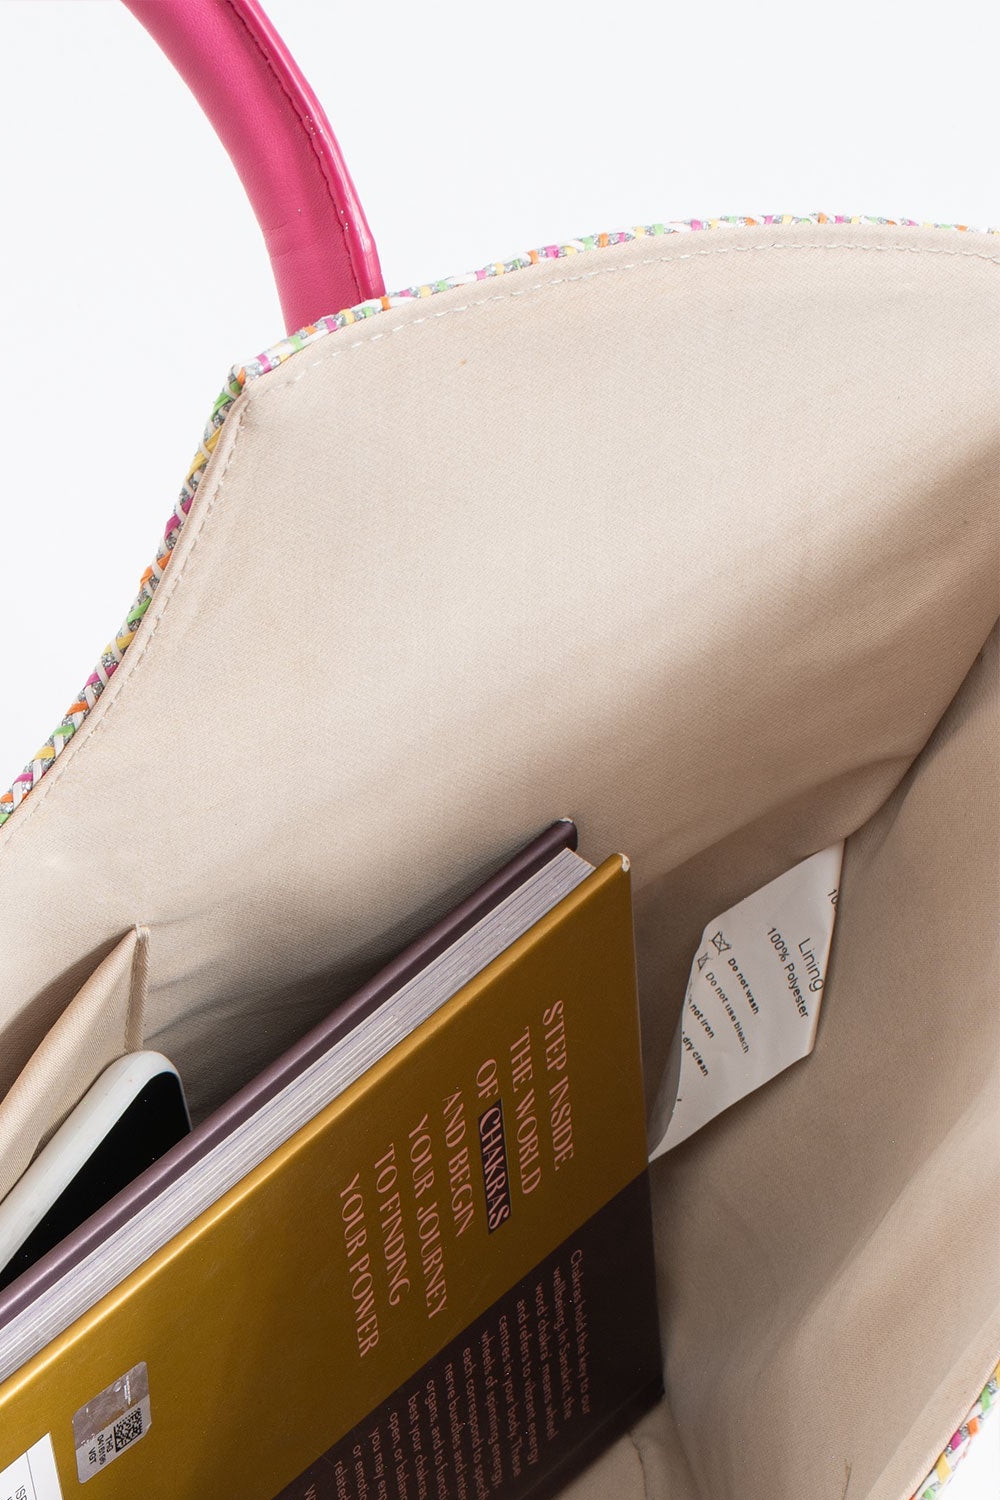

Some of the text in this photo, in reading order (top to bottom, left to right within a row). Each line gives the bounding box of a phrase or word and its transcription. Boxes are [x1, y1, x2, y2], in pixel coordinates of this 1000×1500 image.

[727, 957, 760, 1015] Do not wash
[767, 927, 809, 1018] 100% Polyester
[798, 937, 825, 992] Lining
[689, 1003, 704, 1020] not
[700, 1018, 715, 1039] iron
[705, 971, 750, 1054] Do not use bleach
[682, 1036, 709, 1077] dry clean
[542, 1000, 574, 1170] STEP INSIDE
[510, 1026, 541, 1194] THE WORLD
[443, 1091, 474, 1236] AND BEGIN
[476, 1058, 509, 1229] OF CHAKRAS
[374, 1142, 410, 1305] TO FINDING
[408, 1114, 447, 1318] YOUR JOURNEY
[340, 1173, 379, 1356] YOUR POWER
[535, 1282, 548, 1317] word
[553, 1266, 566, 1331] wellbeing.
[481, 1330, 496, 1375] wheels
[558, 1327, 569, 1346] In
[571, 1249, 591, 1415] Chakras hold the key to our
[444, 1362, 456, 1400] nerve
[462, 1347, 477, 1378] each
[484, 1375, 499, 1390] of
[516, 1298, 539, 1465] and refers to vibrant energy
[542, 1363, 552, 1404] means
[407, 1391, 420, 1425] best
[424, 1379, 438, 1426] organs,
[465, 1378, 484, 1449] correspond
[498, 1314, 523, 1477] centres in your body. These
[563, 1396, 575, 1420] the
[387, 1411, 401, 1449] open,
[408, 1423, 422, 1452] your
[431, 1425, 445, 1451] and
[448, 1396, 464, 1450] bundles
[484, 1390, 500, 1445] spinning
[545, 1403, 559, 1441] wheel
[352, 1444, 362, 1459] or
[368, 1426, 381, 1453] you
[393, 1447, 403, 1462] or
[433, 1448, 444, 1466] to
[472, 1446, 483, 1464] to
[373, 1452, 384, 1480] may
[414, 1454, 429, 1500] chakras
[453, 1449, 467, 1474] and
